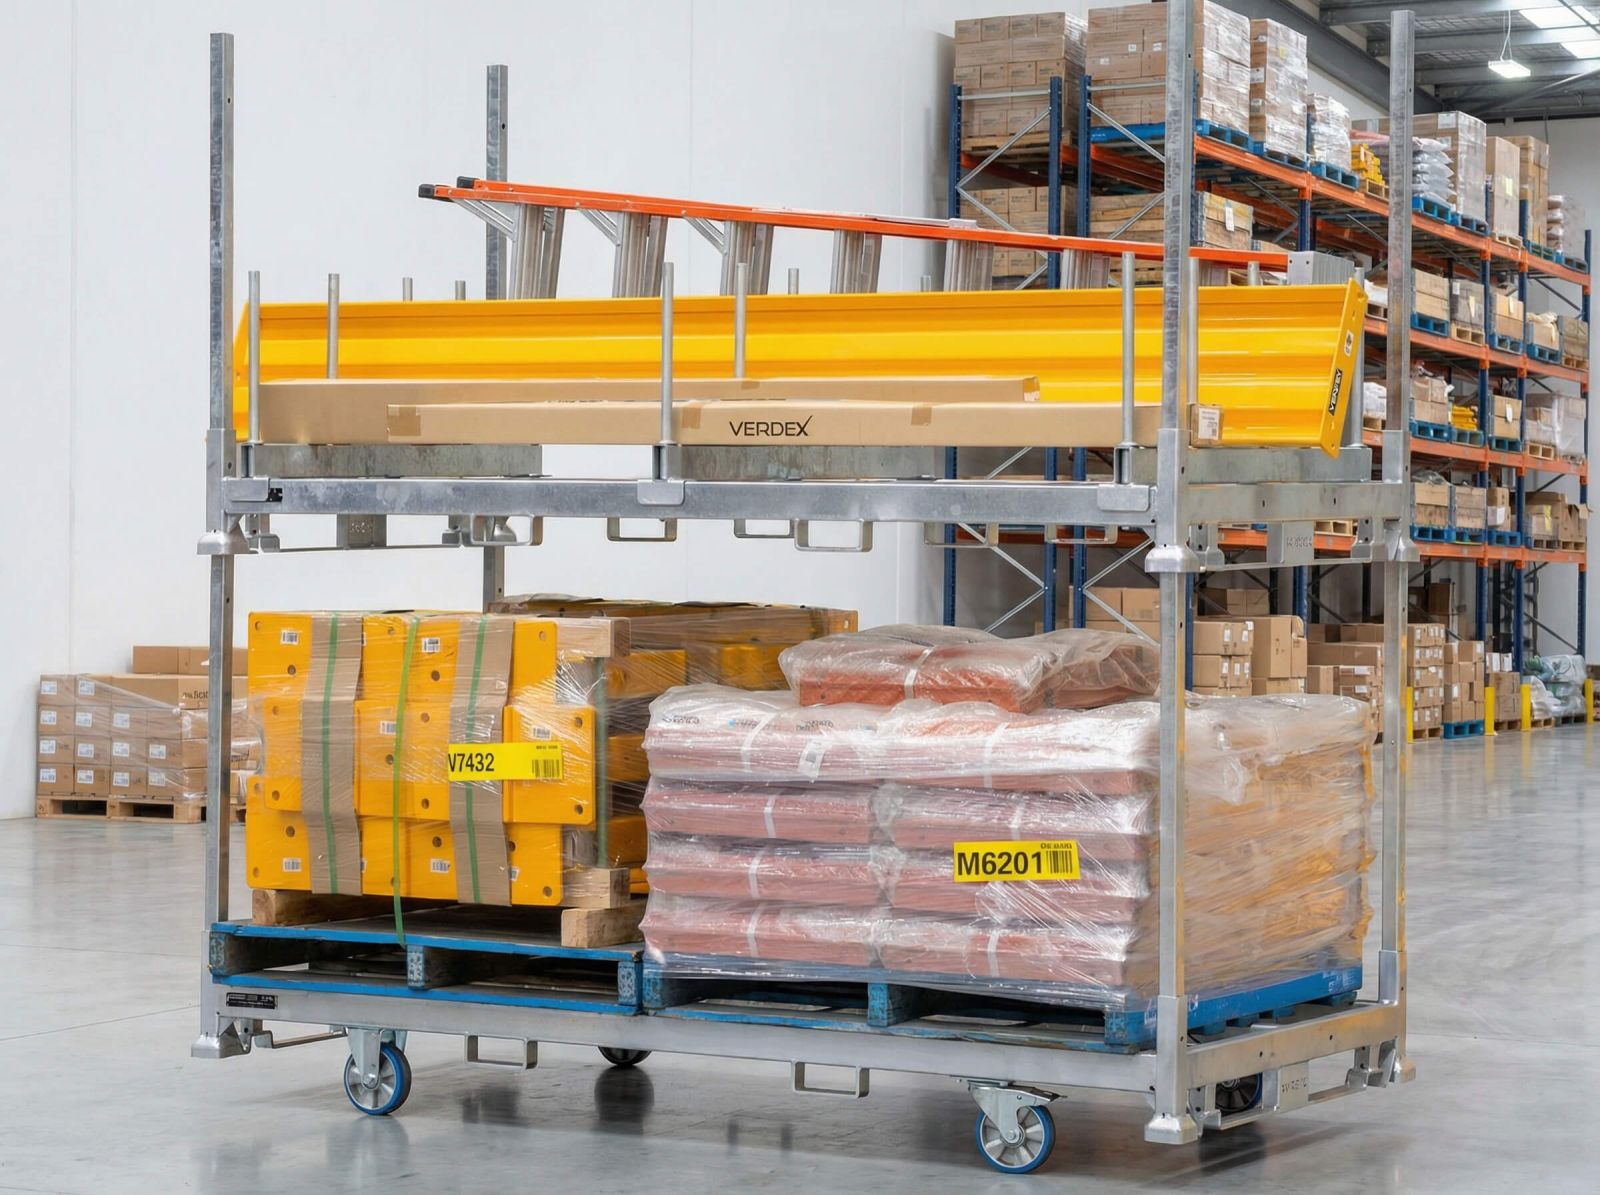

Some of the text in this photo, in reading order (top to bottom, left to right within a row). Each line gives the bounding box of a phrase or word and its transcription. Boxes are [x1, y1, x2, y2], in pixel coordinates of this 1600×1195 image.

[729, 415, 813, 437] VERDEX
[448, 753, 495, 772] V7432
[957, 851, 1042, 876] M6201
